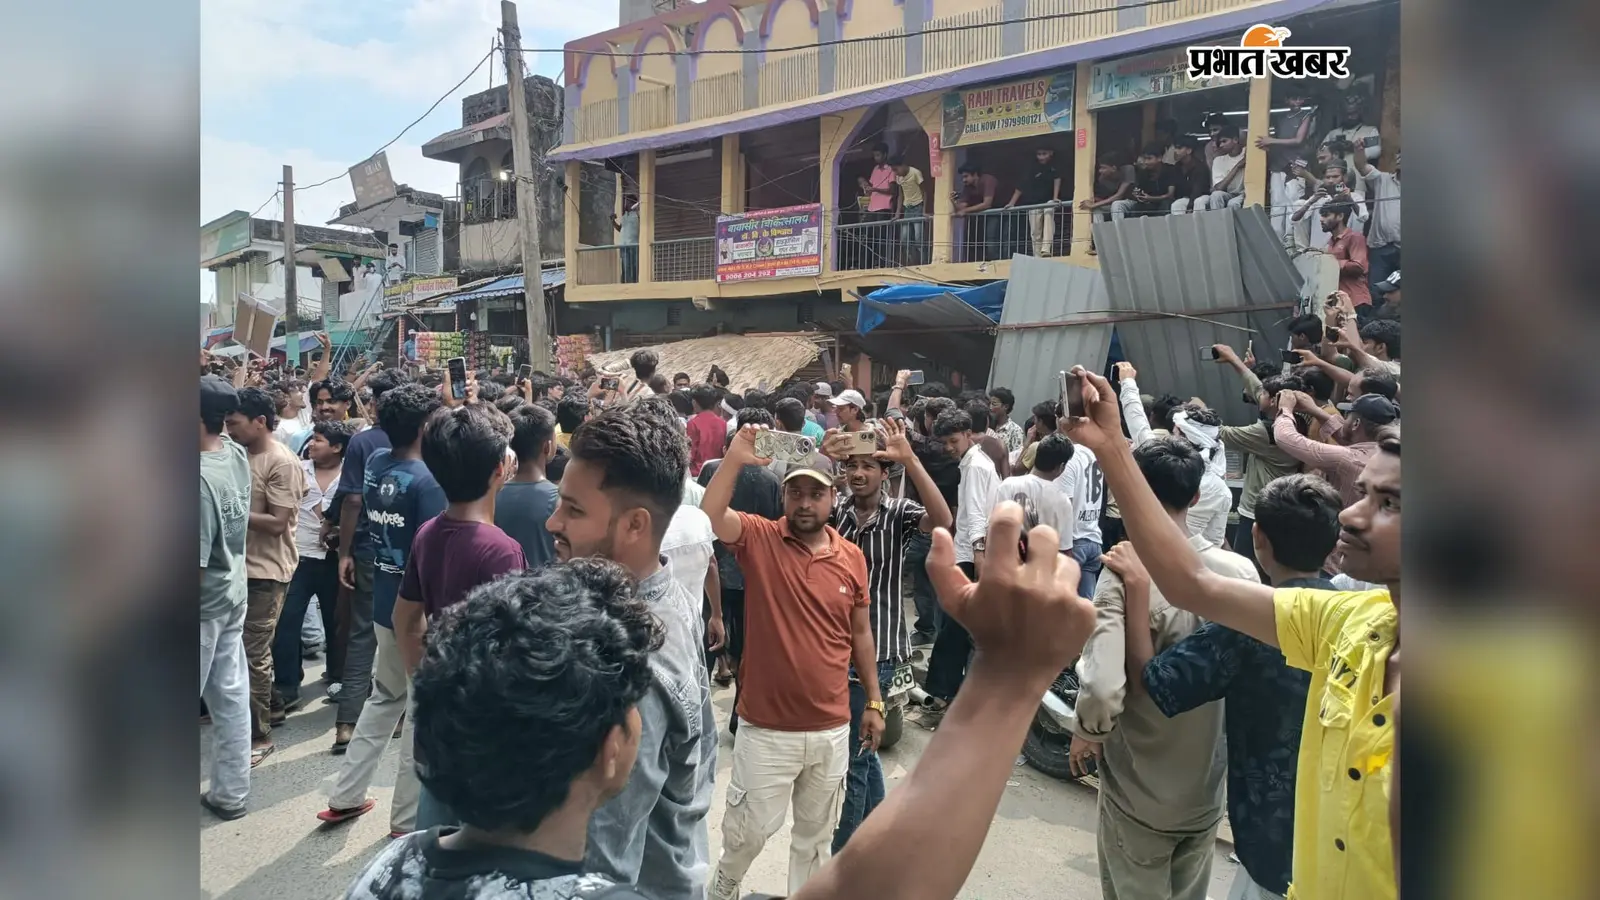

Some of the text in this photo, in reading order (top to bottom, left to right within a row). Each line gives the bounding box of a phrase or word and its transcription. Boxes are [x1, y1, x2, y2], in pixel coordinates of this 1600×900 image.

[967, 81, 1045, 109] RAHI TRAVELS
[965, 122, 981, 134] CALL
[981, 120, 996, 132] NOW
[760, 214, 809, 229] चिकित्सालय
